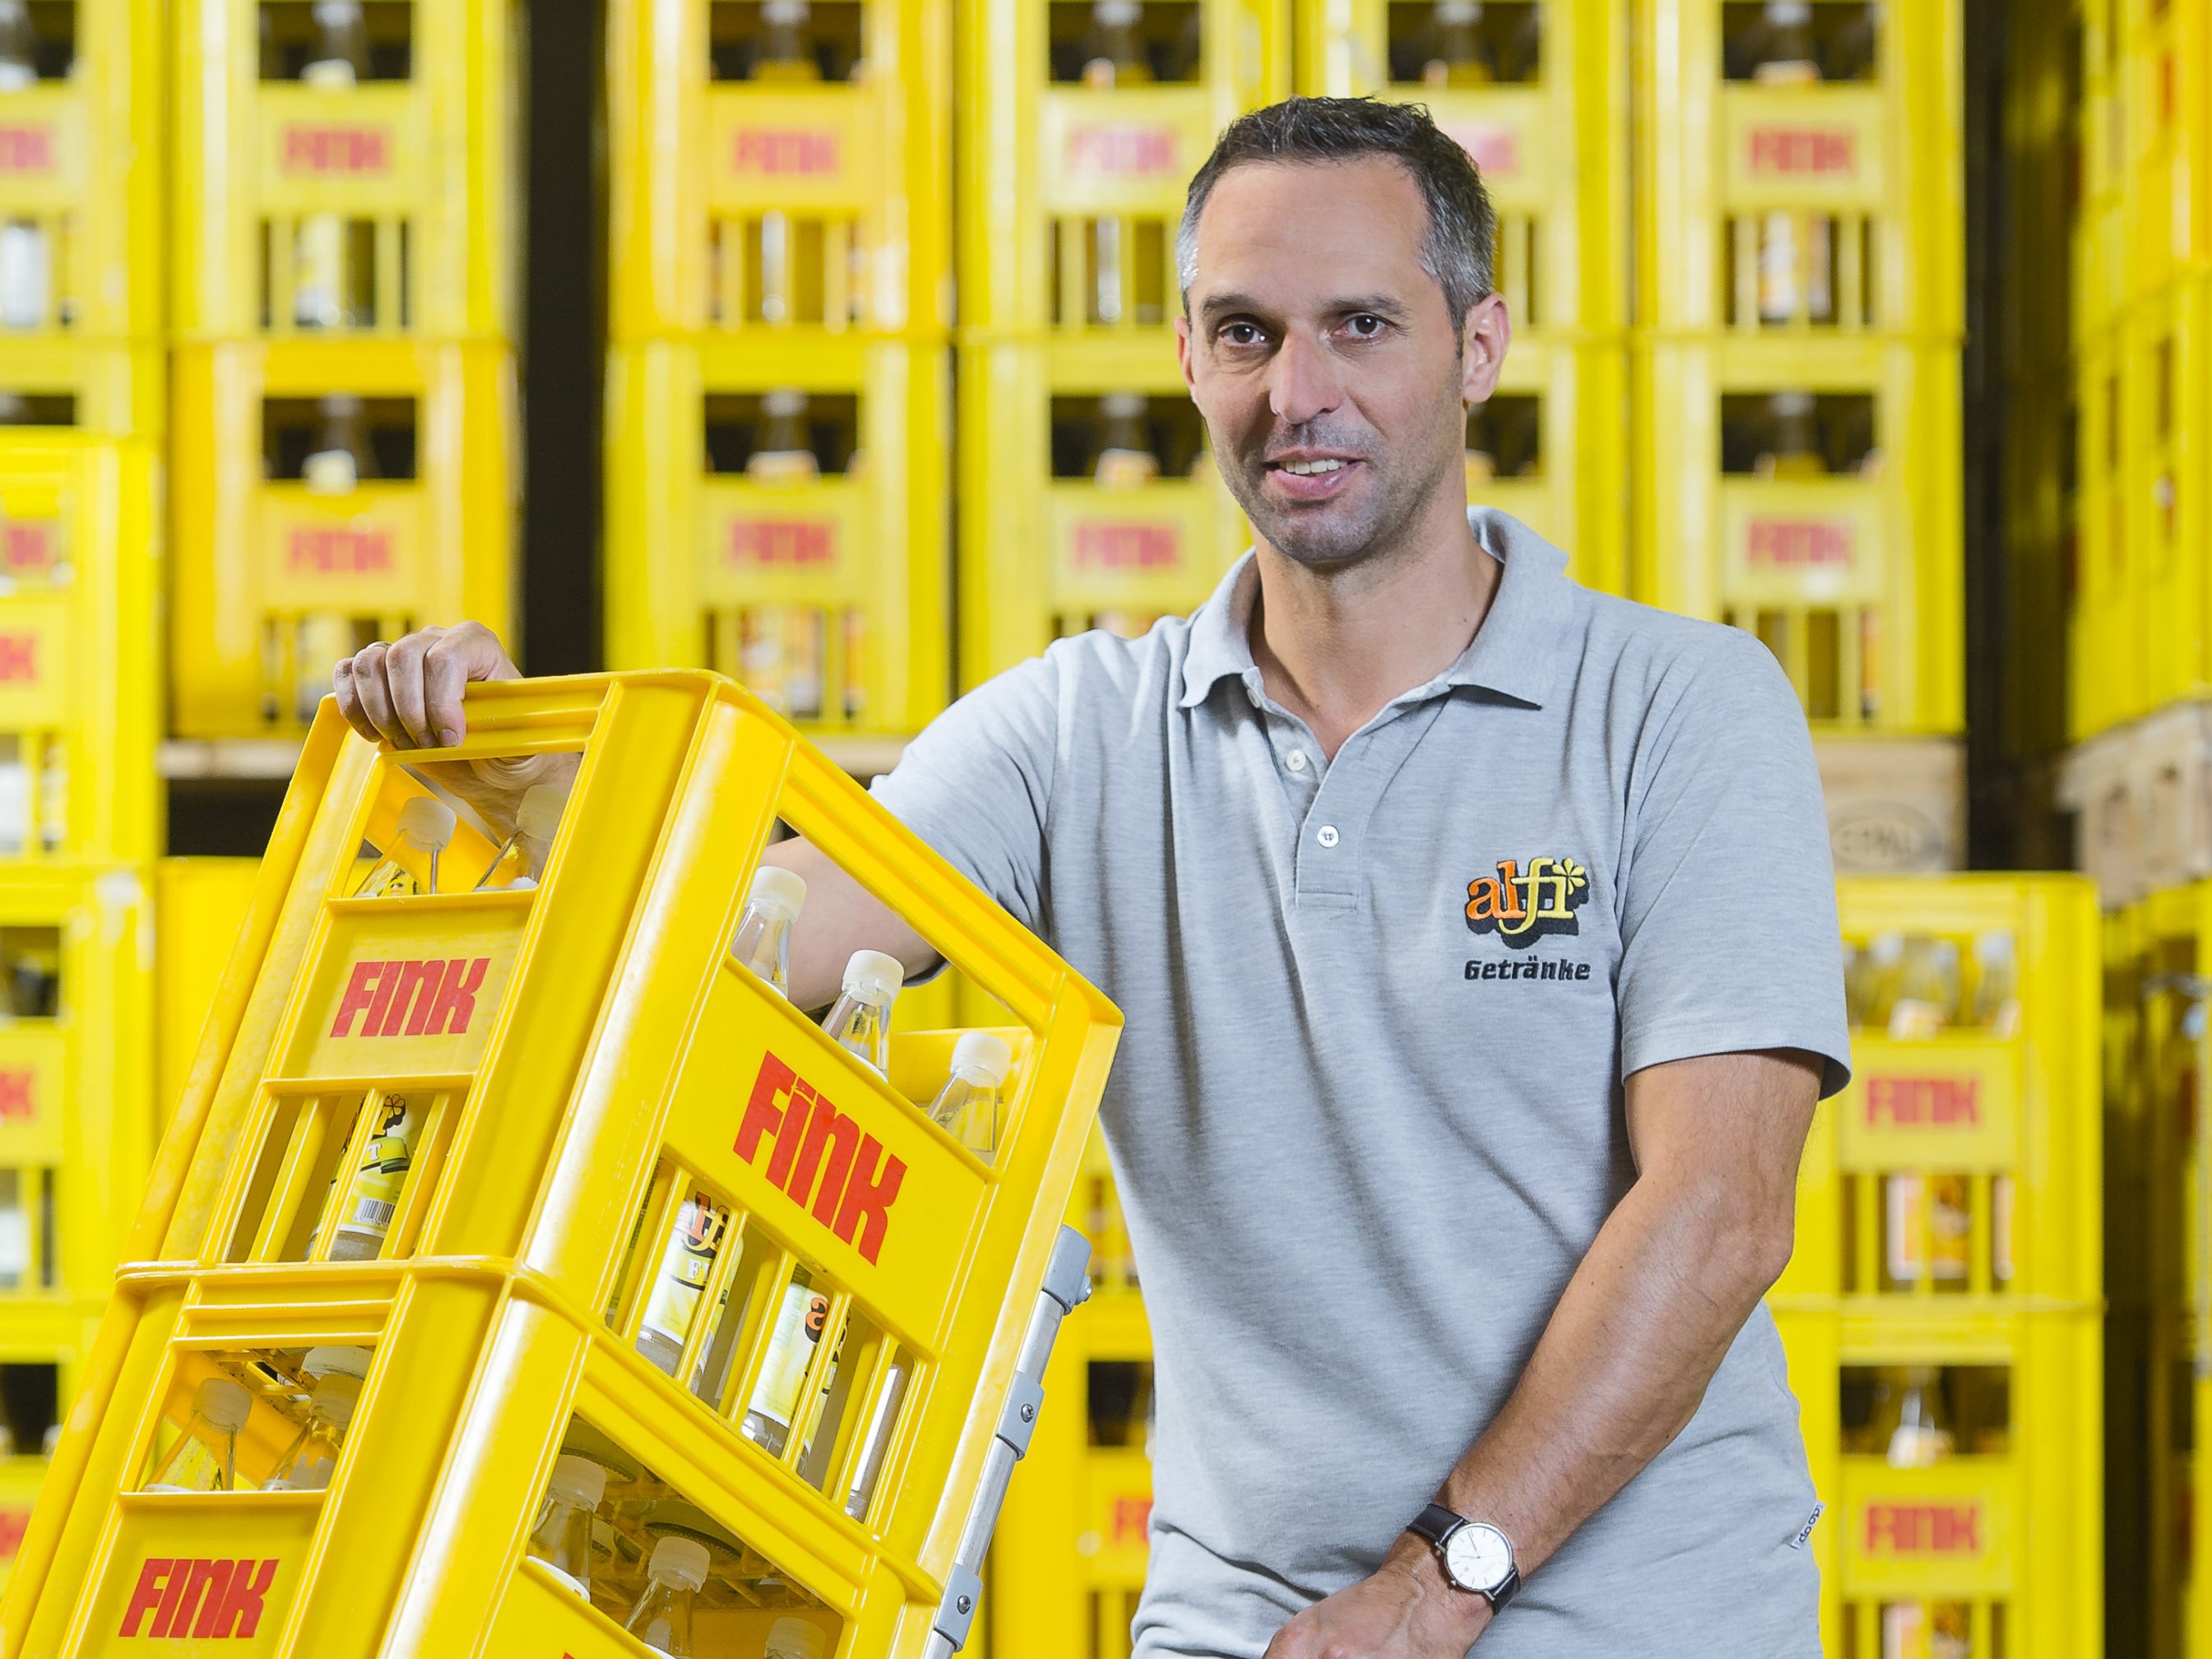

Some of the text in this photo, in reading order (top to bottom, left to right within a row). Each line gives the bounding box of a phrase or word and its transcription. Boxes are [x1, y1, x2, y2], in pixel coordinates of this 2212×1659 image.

[330, 957, 490, 1037] FINK
[1464, 955, 1591, 980] Getränke
[1863, 1073, 1980, 1127] FINK
[733, 1050, 907, 1267] FINK
[1863, 1502, 1980, 1555] FINK
[118, 1558, 280, 1639] FINK
